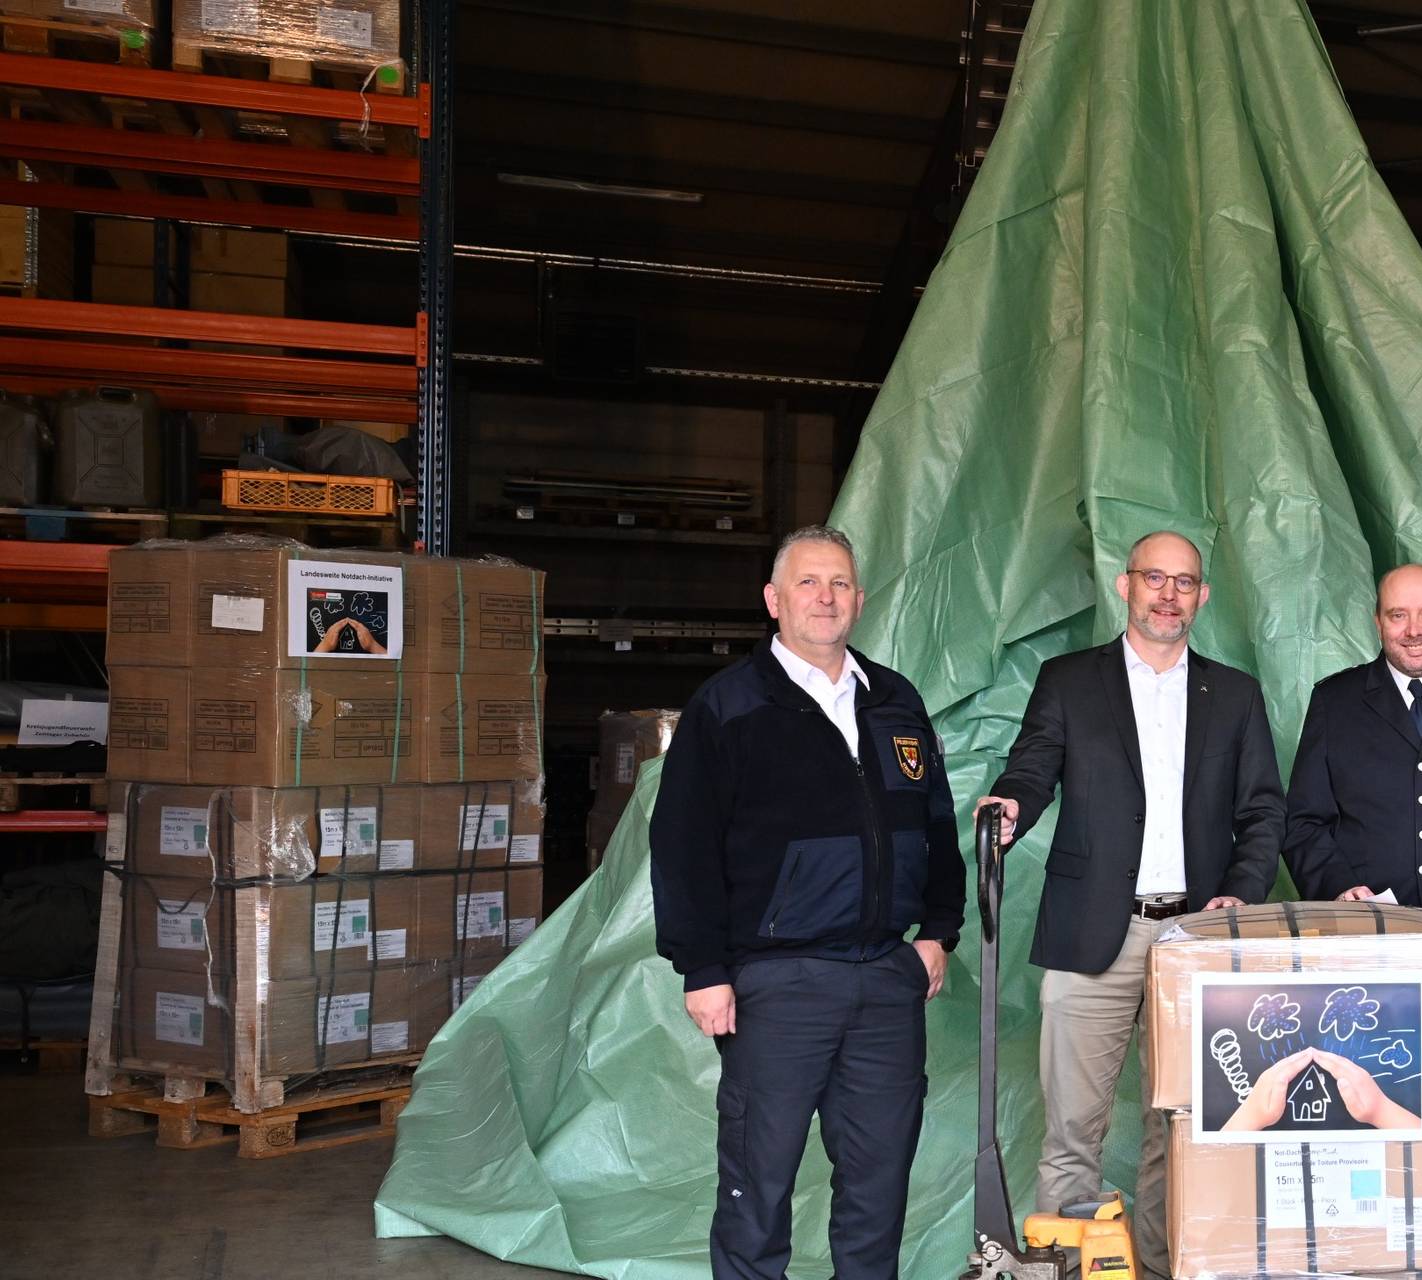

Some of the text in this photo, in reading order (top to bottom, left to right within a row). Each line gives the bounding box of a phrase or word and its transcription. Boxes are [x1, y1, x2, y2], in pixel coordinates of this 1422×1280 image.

[300, 570, 393, 583] Landesweite Notdach-Initiative
[1338, 1158, 1368, 1166] Provisoire
[1276, 1175, 1295, 1185] 15m
